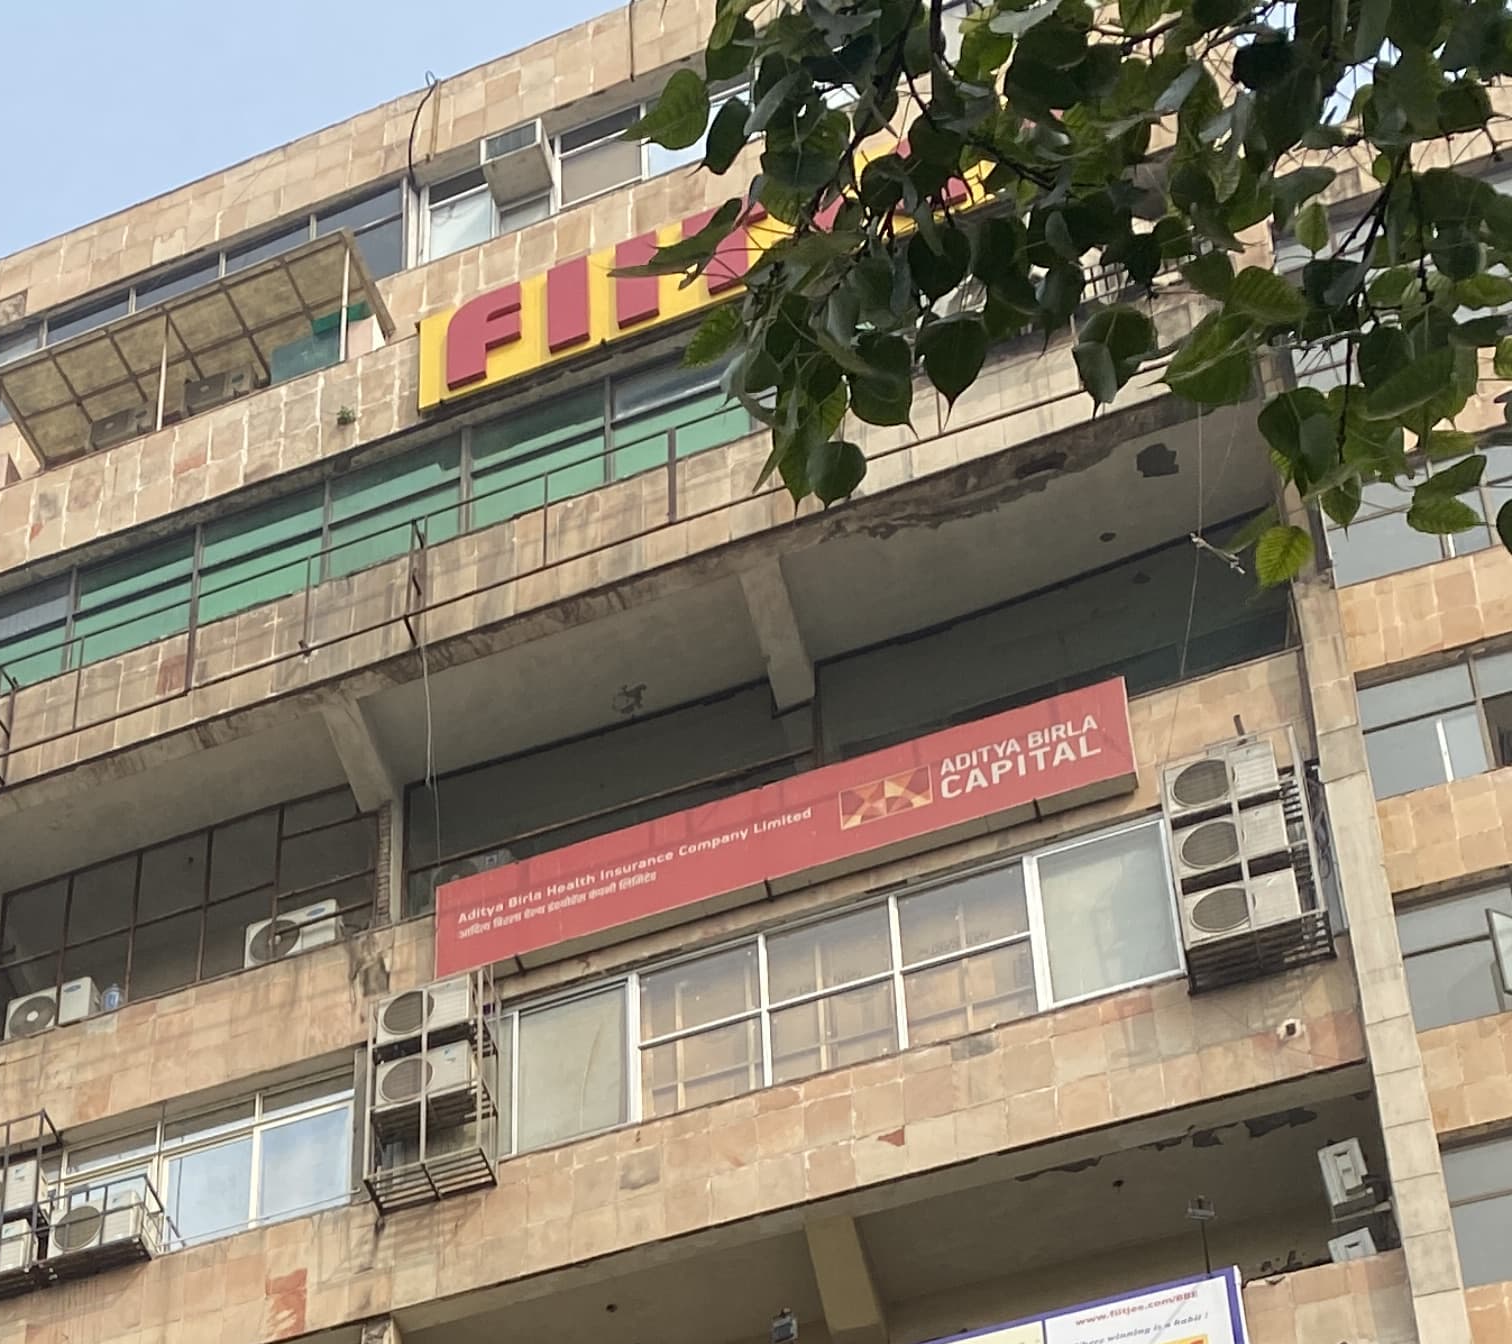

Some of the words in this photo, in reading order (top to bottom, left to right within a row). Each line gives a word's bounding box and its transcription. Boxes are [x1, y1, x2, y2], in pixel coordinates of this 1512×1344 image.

[940, 738, 1021, 776] ADITYA
[1027, 714, 1098, 750] BIRLA
[940, 735, 1101, 799] CAPITAL
[458, 901, 504, 925] Aditya
[508, 890, 542, 908] Birla
[546, 874, 596, 897] Health
[600, 851, 674, 880] Insurance
[678, 827, 749, 857] Company
[753, 807, 812, 834] Limited
